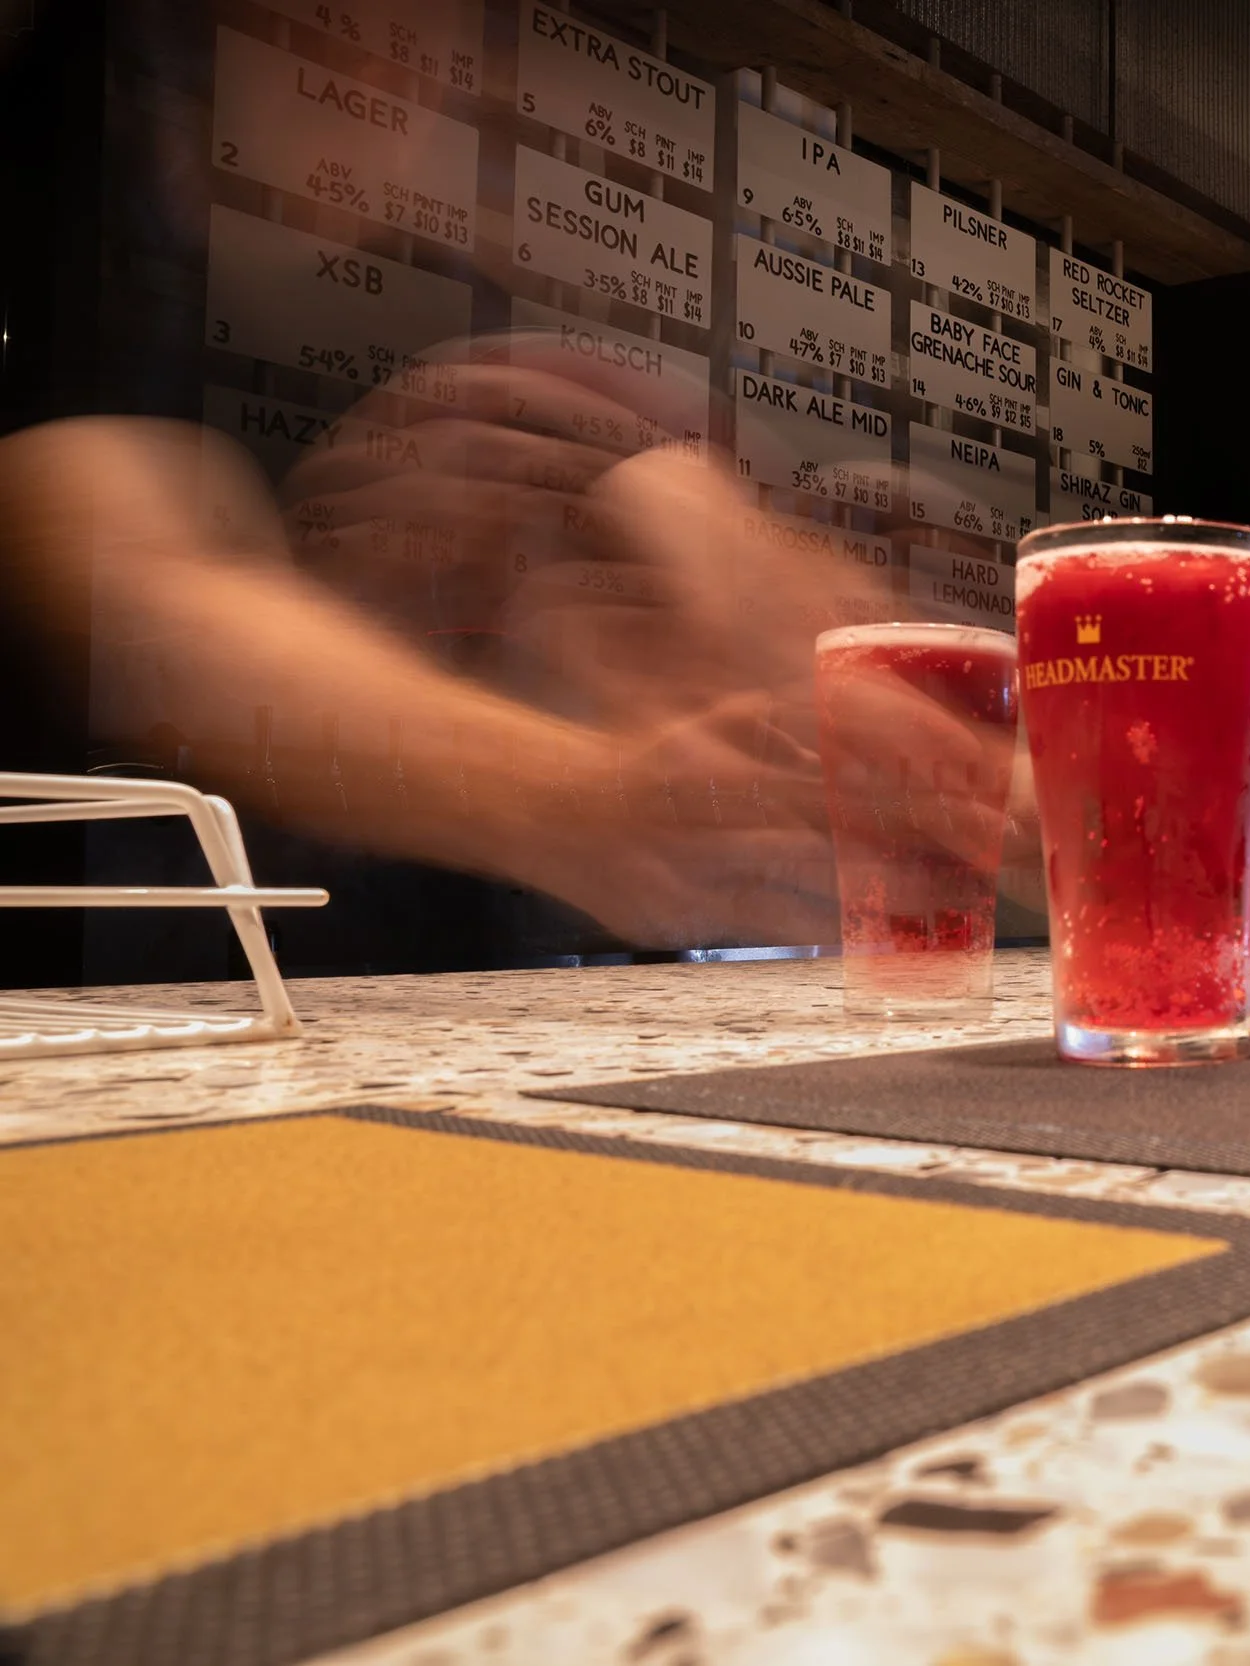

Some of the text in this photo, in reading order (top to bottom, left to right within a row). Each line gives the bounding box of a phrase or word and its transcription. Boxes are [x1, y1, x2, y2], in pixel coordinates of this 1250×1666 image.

[390, 21, 473, 68] SCH IMP
[533, 7, 705, 109] EXTRA STOUT
[391, 41, 409, 63] $8
[450, 66, 473, 89] $14
[297, 67, 408, 136] LAGER
[523, 93, 535, 112] 5
[589, 102, 705, 162] ABV SCH PINT IMP
[221, 142, 238, 166] 2
[585, 119, 702, 182] 6% $8 $11 $14
[802, 137, 840, 176] IPA
[316, 157, 351, 180] ABV
[383, 182, 408, 201] SCH
[447, 205, 467, 222] IMP
[585, 181, 644, 223] GUM
[743, 188, 753, 204] 9
[385, 202, 405, 222] $7
[414, 211, 439, 233] $10
[445, 221, 467, 244] $13
[793, 195, 884, 245] ABV SCH IMP
[943, 204, 1007, 250] PILSNER
[518, 243, 531, 262] 6
[527, 197, 698, 279] SESSION ALE
[838, 230, 850, 248] $8
[853, 236, 864, 253] $11
[869, 243, 882, 261] $14
[316, 250, 383, 295] XSB
[754, 249, 874, 311] AUSSIE PALE
[912, 259, 925, 276] 13
[1064, 258, 1145, 310] RED ROCKET
[631, 271, 702, 303] SCH PINT IMP
[987, 279, 1000, 292] SCH
[633, 286, 647, 305] $8
[658, 295, 672, 314] $11
[684, 302, 701, 321] $14
[990, 292, 999, 306] $7
[1002, 297, 1013, 312] $10
[1017, 303, 1029, 319] $13
[1072, 287, 1129, 328] SELTZER
[212, 321, 230, 343] 3
[739, 321, 754, 340] 10
[931, 312, 1020, 365] BABY FACE
[1053, 316, 1062, 331] 17
[368, 345, 394, 365] SCH
[561, 325, 662, 377] KOLSCH
[800, 327, 885, 366] ABV SCH PINT IMP
[1089, 336, 1105, 352] 4%
[830, 351, 841, 367] $7
[850, 359, 865, 376] $10
[872, 366, 885, 383] $13
[912, 332, 1035, 394] GRENACHE SOUR
[372, 365, 392, 385] $7
[402, 373, 425, 394] $10
[433, 381, 456, 403] $13
[913, 378, 926, 395] 14
[1057, 367, 1149, 416] GIN & TONIC
[513, 398, 525, 417] 7
[744, 375, 887, 437] DARK ALE MID
[992, 404, 1001, 418] $9
[1005, 410, 1016, 424] $12
[1020, 414, 1030, 428] $15
[241, 403, 342, 449] HAZY
[684, 430, 701, 441] IMP
[1053, 426, 1063, 441] 18
[952, 439, 1000, 472] NEIPA
[1089, 440, 1105, 457] 5%
[739, 458, 751, 476] 11
[800, 460, 818, 472] ABV
[833, 467, 849, 481] SCH
[835, 481, 846, 497] $7
[854, 486, 869, 503] $10
[875, 492, 888, 508] $13
[912, 501, 925, 518] 15
[1061, 473, 1140, 512] SHIRAZ GIN
[960, 500, 1003, 520] ABV SCH
[744, 518, 887, 567] BAROSSA MILD
[514, 553, 527, 572] 8
[953, 559, 998, 585] HARD
[933, 581, 1015, 617] LEMONAD
